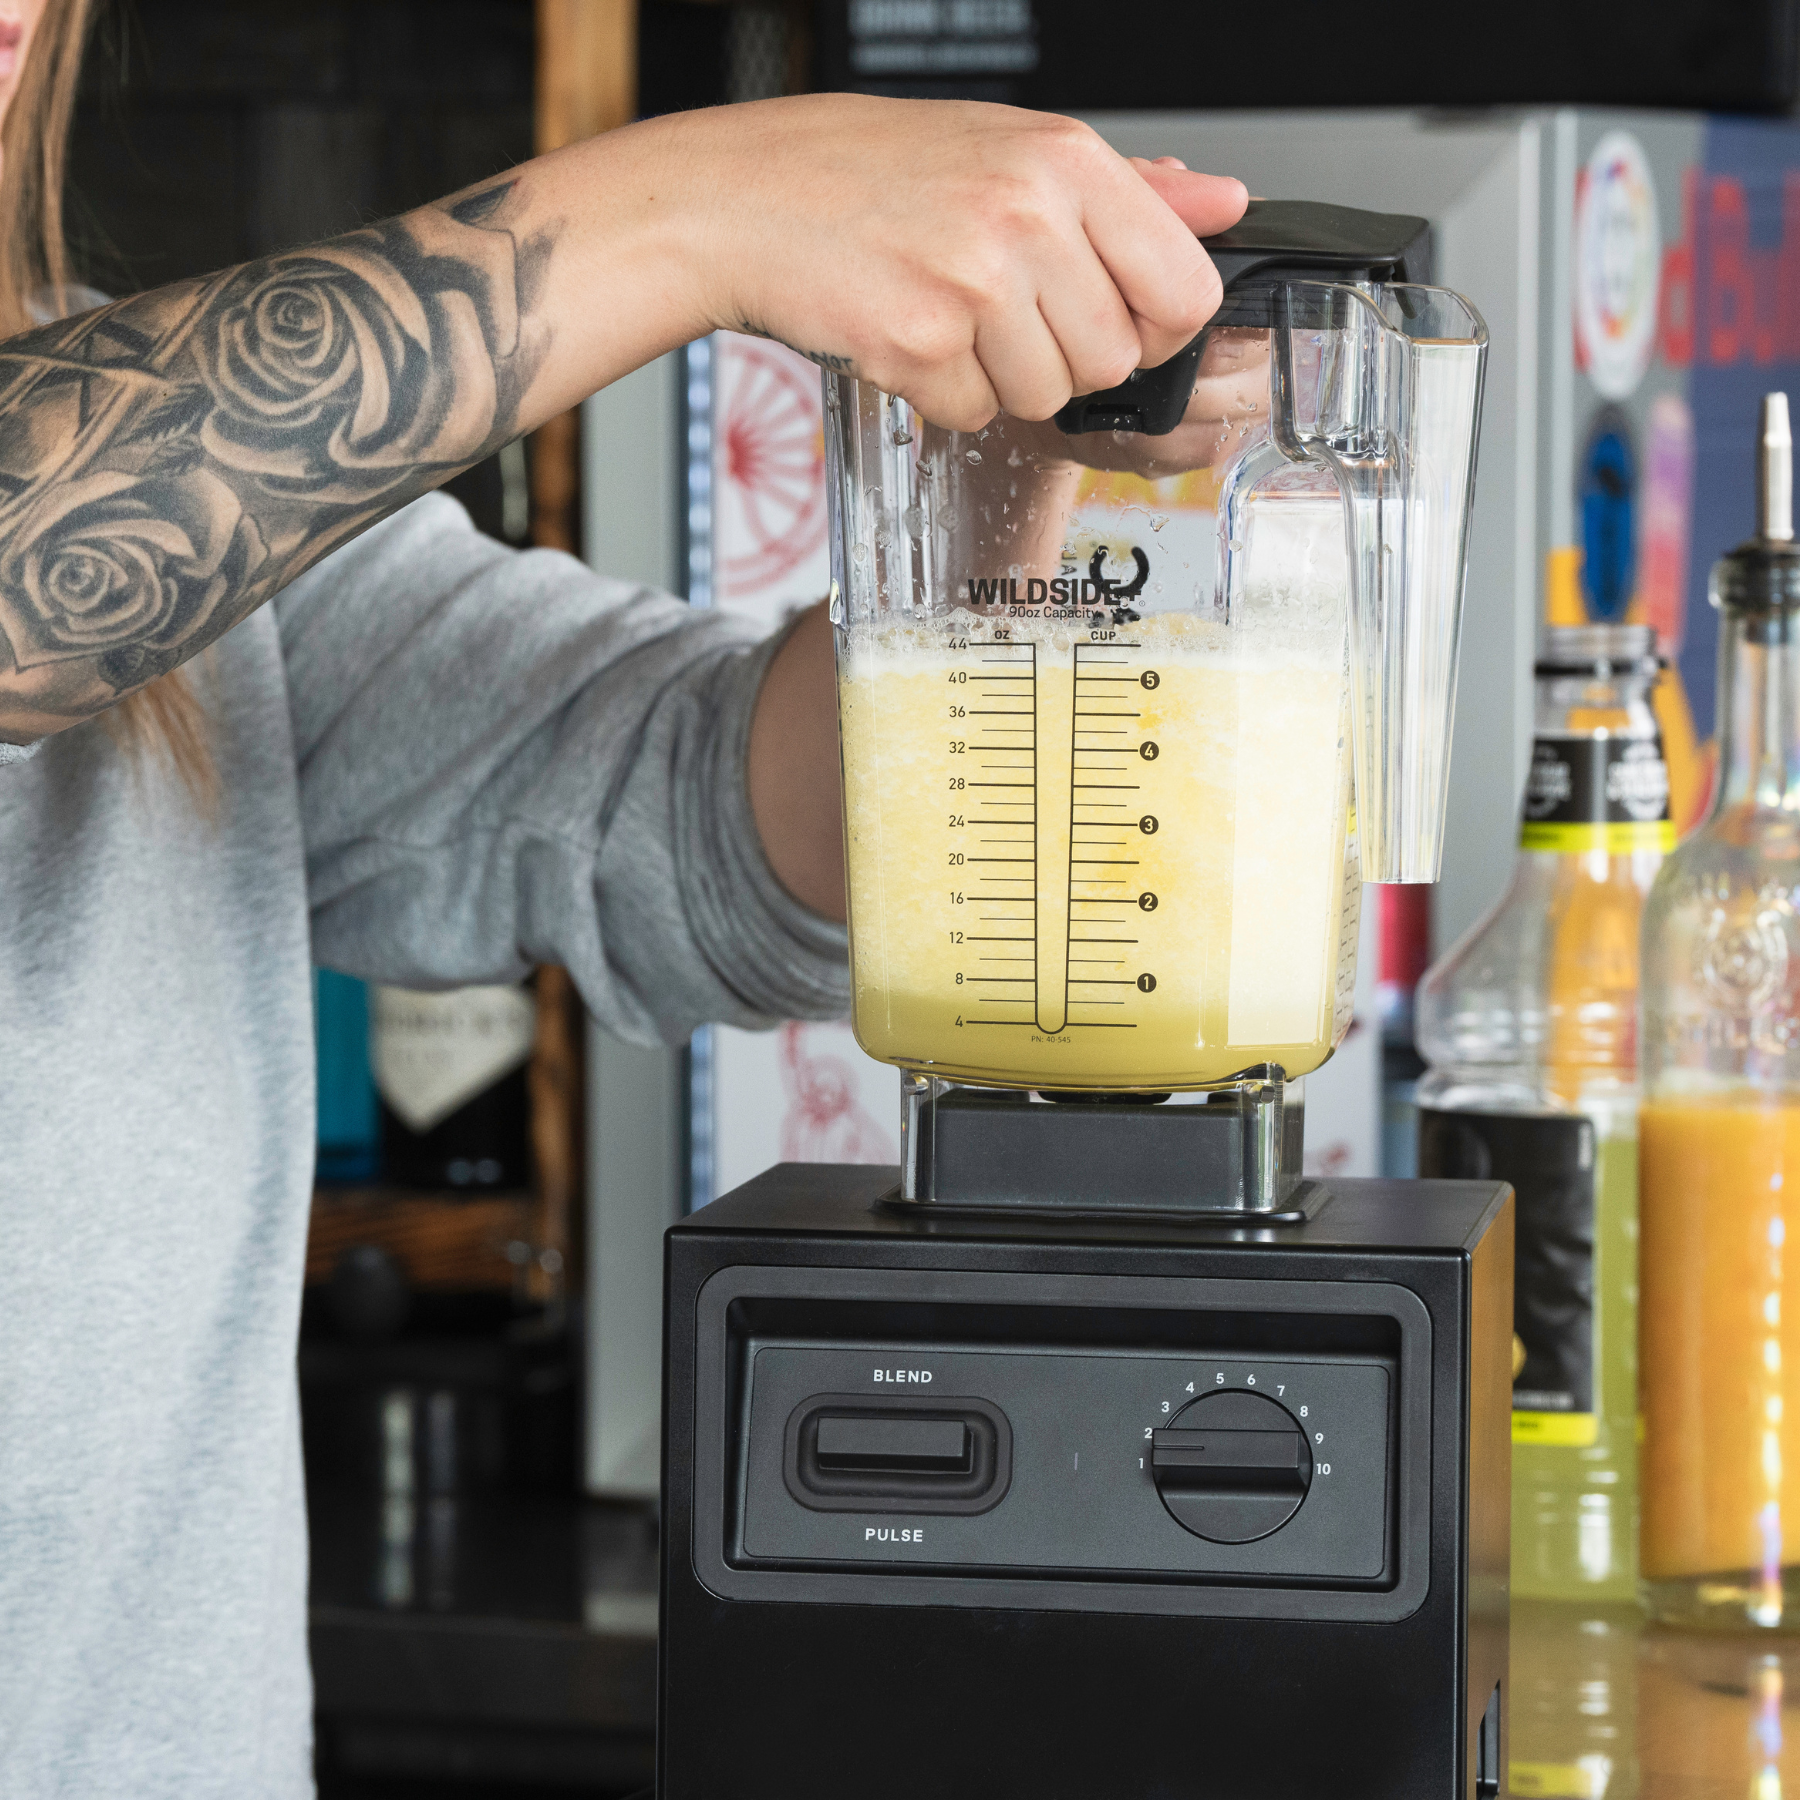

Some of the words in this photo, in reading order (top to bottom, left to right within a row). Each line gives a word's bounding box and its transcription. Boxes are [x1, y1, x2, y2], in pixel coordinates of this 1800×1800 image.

[1009, 605, 1039, 618] 90oz
[1043, 605, 1099, 620] Capacity
[1090, 630, 1117, 641] CUP
[948, 637, 967, 650] 44
[948, 671, 967, 684] 40
[949, 705, 966, 718] 36
[949, 741, 966, 754] 32
[948, 777, 966, 790] 28
[948, 814, 965, 828] 24
[948, 852, 965, 866] 20
[950, 891, 964, 905] 16
[949, 931, 964, 944] 12
[955, 972, 964, 985] 8
[954, 1015, 964, 1028] 4
[1031, 1035, 1044, 1043] PN:
[873, 1369, 933, 1383] BLEND
[1215, 1372, 1225, 1385] 5
[1246, 1373, 1256, 1386] 6
[1185, 1381, 1195, 1394] 4
[1276, 1385, 1286, 1397] 7
[1161, 1401, 1170, 1413] 3
[1299, 1405, 1309, 1418] 8
[1144, 1427, 1153, 1439] 2
[1314, 1432, 1324, 1445] 9
[1138, 1457, 1144, 1469] 1
[1316, 1463, 1331, 1476] 10
[865, 1527, 923, 1543] PULSE
